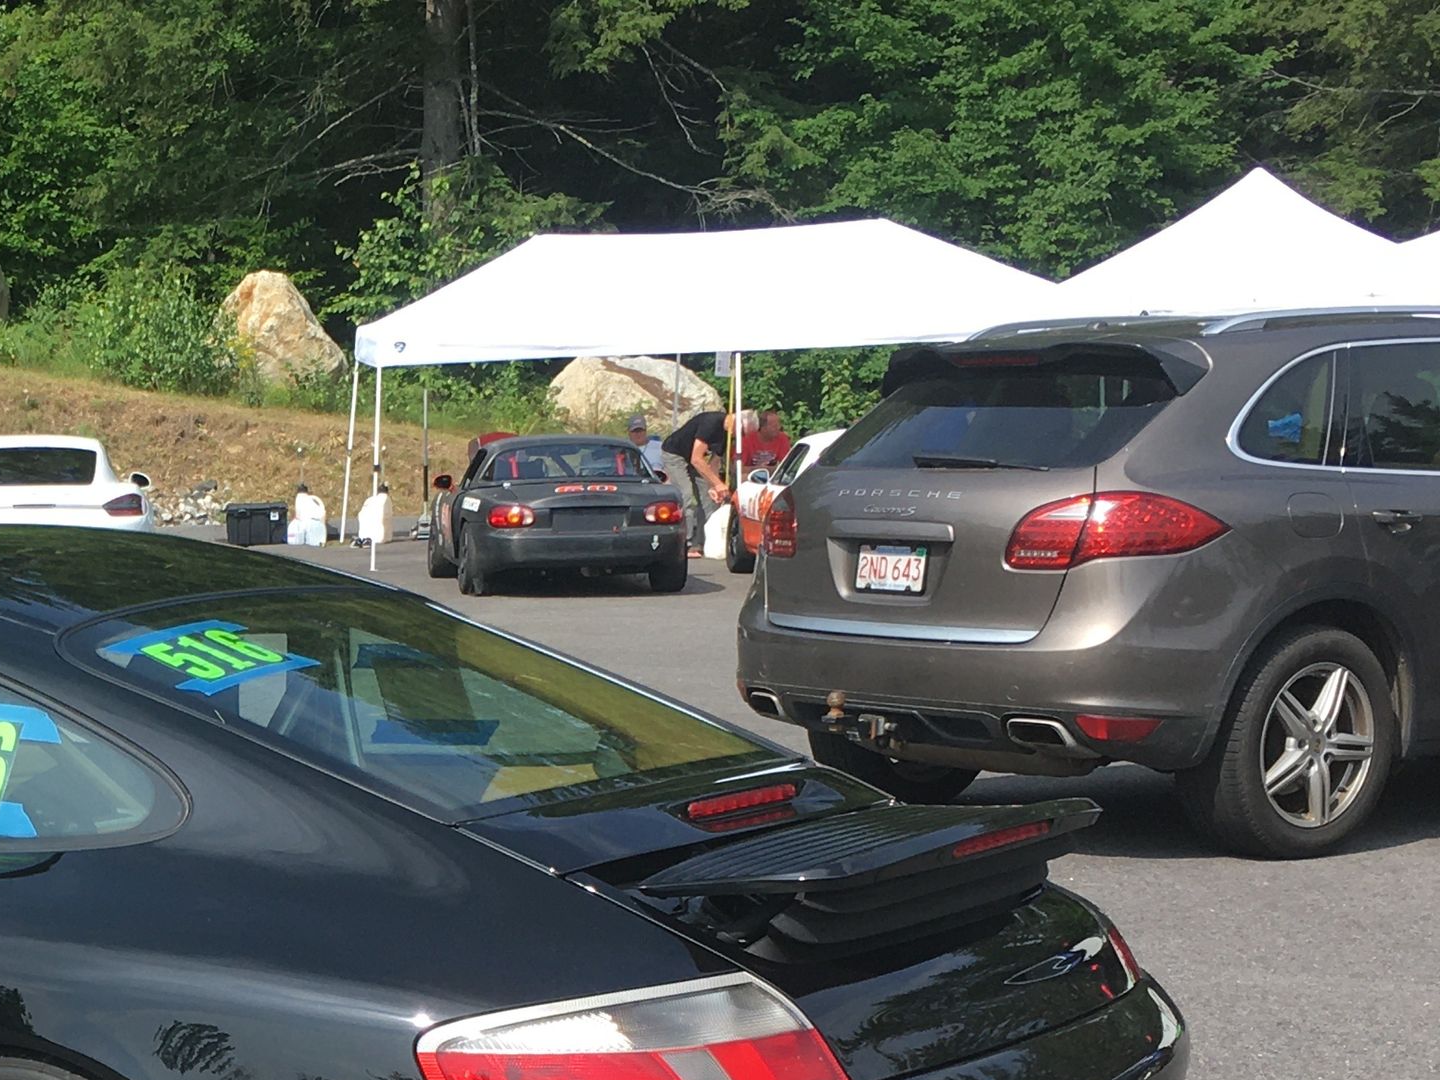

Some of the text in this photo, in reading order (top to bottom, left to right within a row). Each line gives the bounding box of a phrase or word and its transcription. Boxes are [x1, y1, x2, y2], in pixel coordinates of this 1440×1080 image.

[838, 488, 963, 500] PORSCHE
[858, 556, 922, 582] 2ND 643
[140, 630, 283, 679] 516
